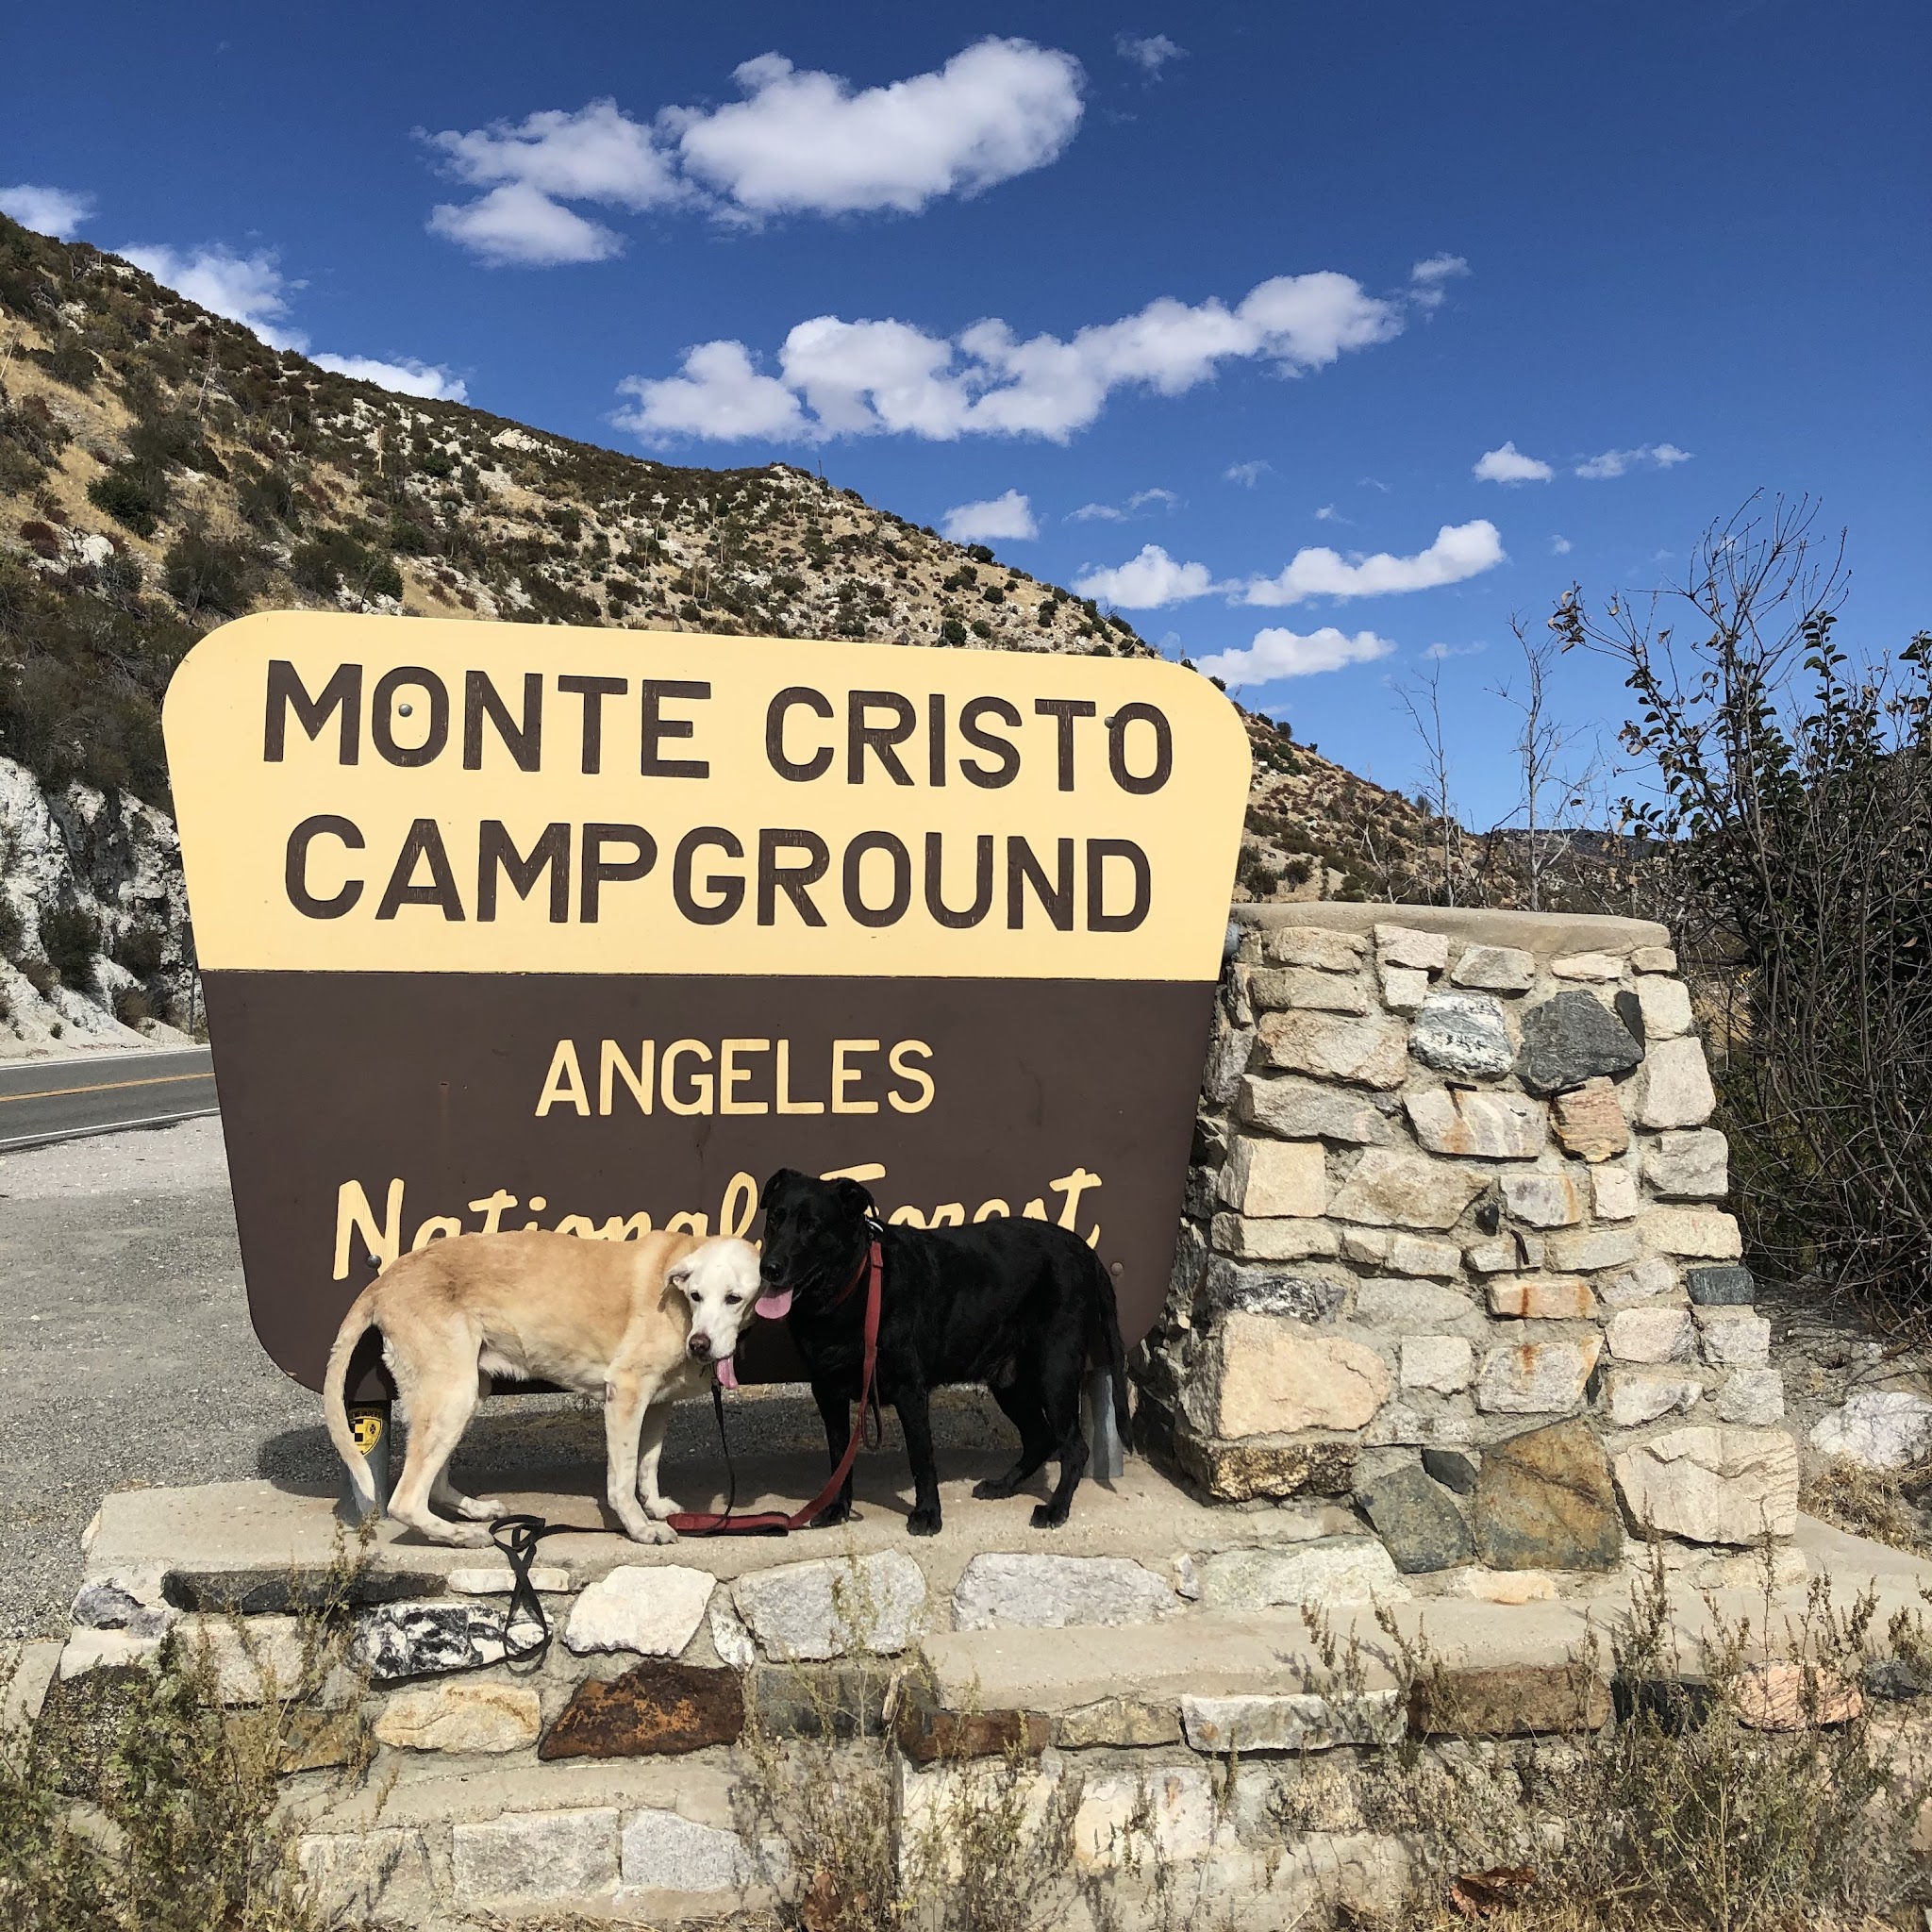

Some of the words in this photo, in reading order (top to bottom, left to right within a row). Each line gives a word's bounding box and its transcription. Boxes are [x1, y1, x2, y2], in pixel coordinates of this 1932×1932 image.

[264, 660, 711, 779] MONTE
[765, 686, 1173, 795] CRISTO
[285, 814, 1152, 933] CAMPGROUND
[535, 1038, 935, 1117] ANGELES
